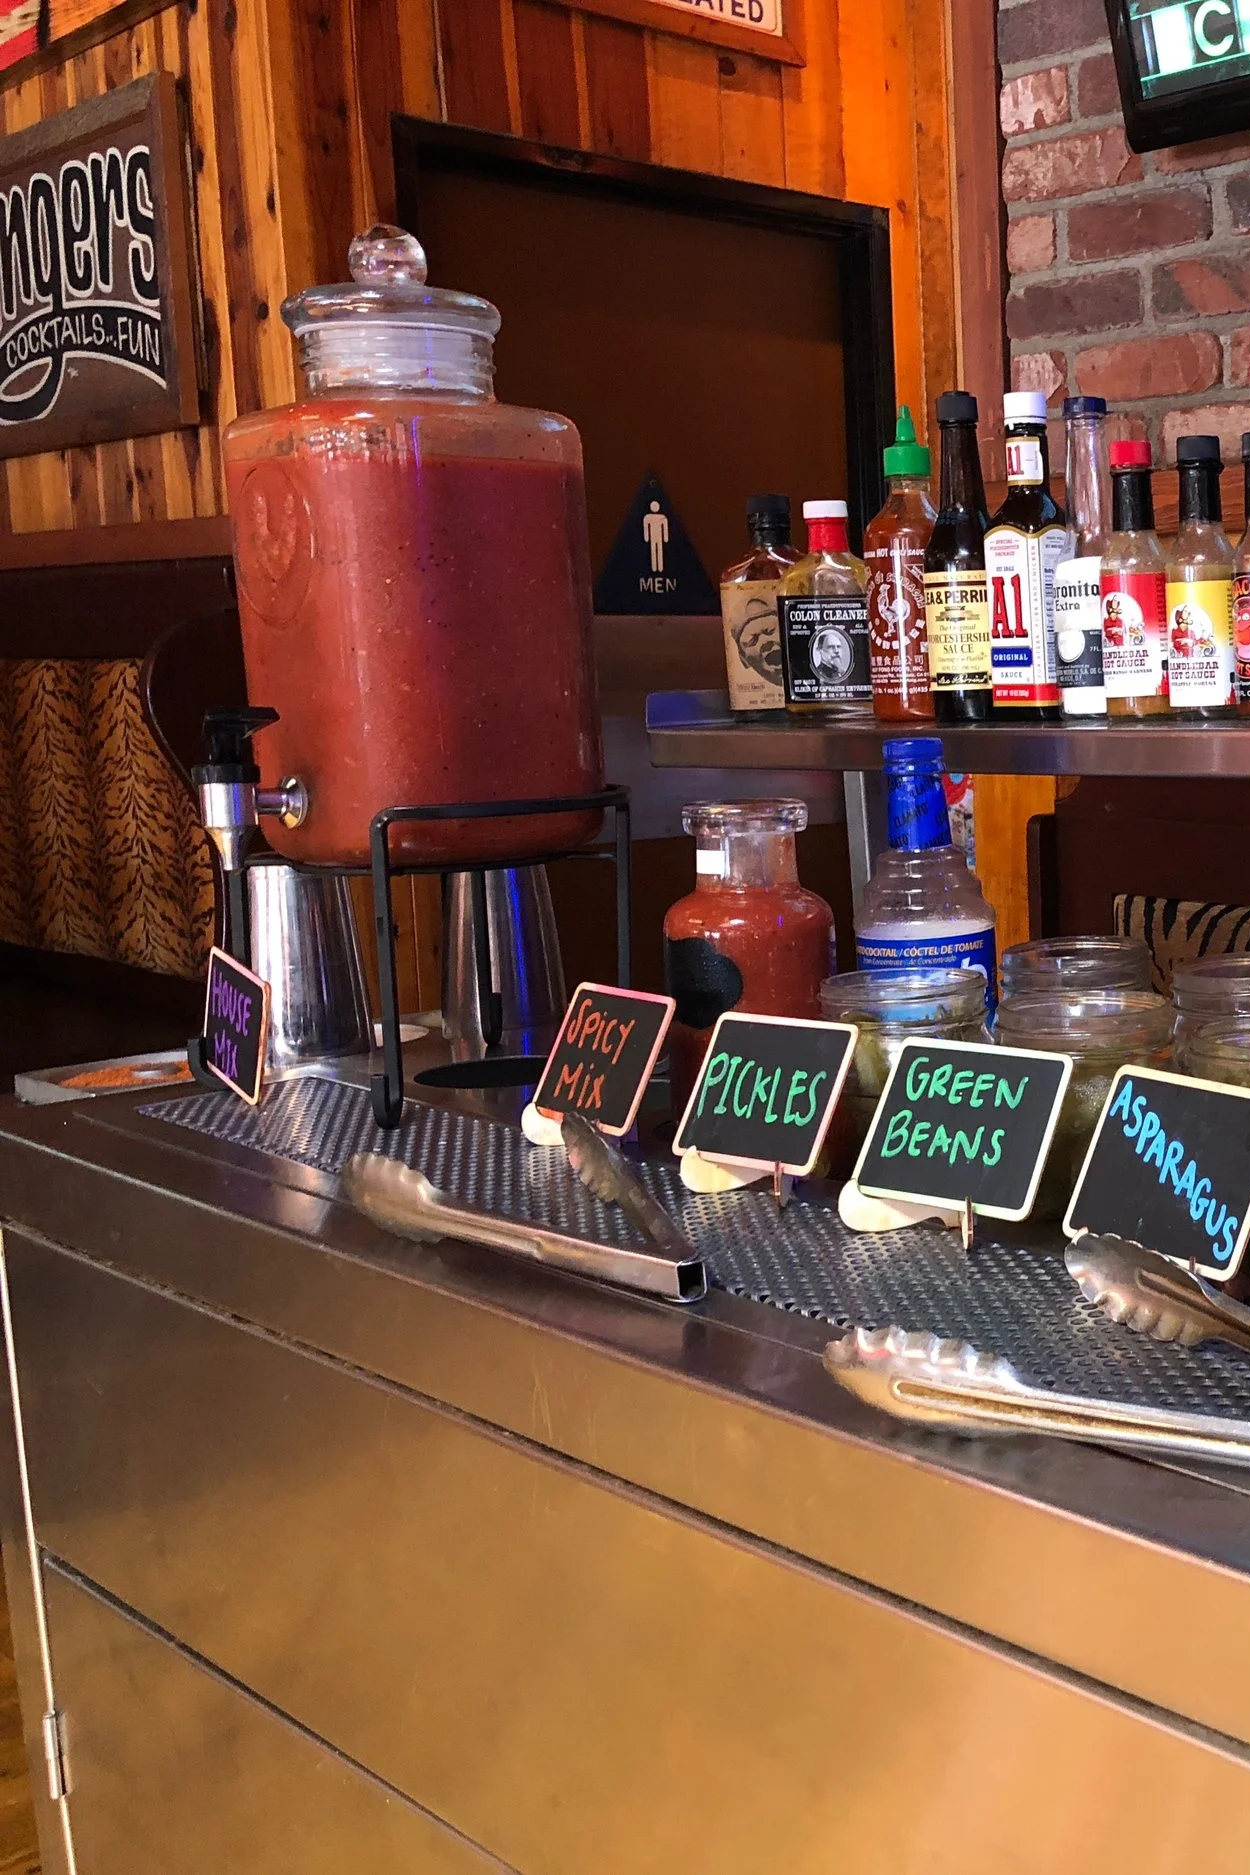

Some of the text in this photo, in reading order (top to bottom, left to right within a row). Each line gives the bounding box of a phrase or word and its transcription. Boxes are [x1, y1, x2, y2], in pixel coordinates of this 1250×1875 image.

[675, 0, 763, 22] TED
[876, 548, 888, 557] HOT
[639, 577, 677, 594] MEN
[886, 571, 925, 608] SRRACHA
[1053, 580, 1100, 599] oronita
[1056, 601, 1080, 612] Extra
[790, 611, 820, 621] COLON
[929, 632, 990, 644] ORCESTERSHI
[993, 653, 1028, 661] ORIGINAL
[1103, 650, 1149, 660] ANDLEBAR
[1116, 659, 1146, 668] SAUCE
[1170, 661, 1219, 671] ANDLEBAR
[1001, 671, 1023, 679] SAUCE
[1185, 670, 1216, 679] SAUCE
[903, 945, 939, 956] CÓCTEL
[941, 945, 953, 954] DE
[954, 940, 984, 953] TOMATE
[212, 966, 252, 1037] HOUSE
[214, 1028, 238, 1078] MIX
[697, 1051, 828, 1126] PICKLES
[906, 1056, 1029, 1110] GREEN
[880, 1109, 1006, 1167] BEANS
[1109, 1079, 1239, 1261] ASPARAGUS
